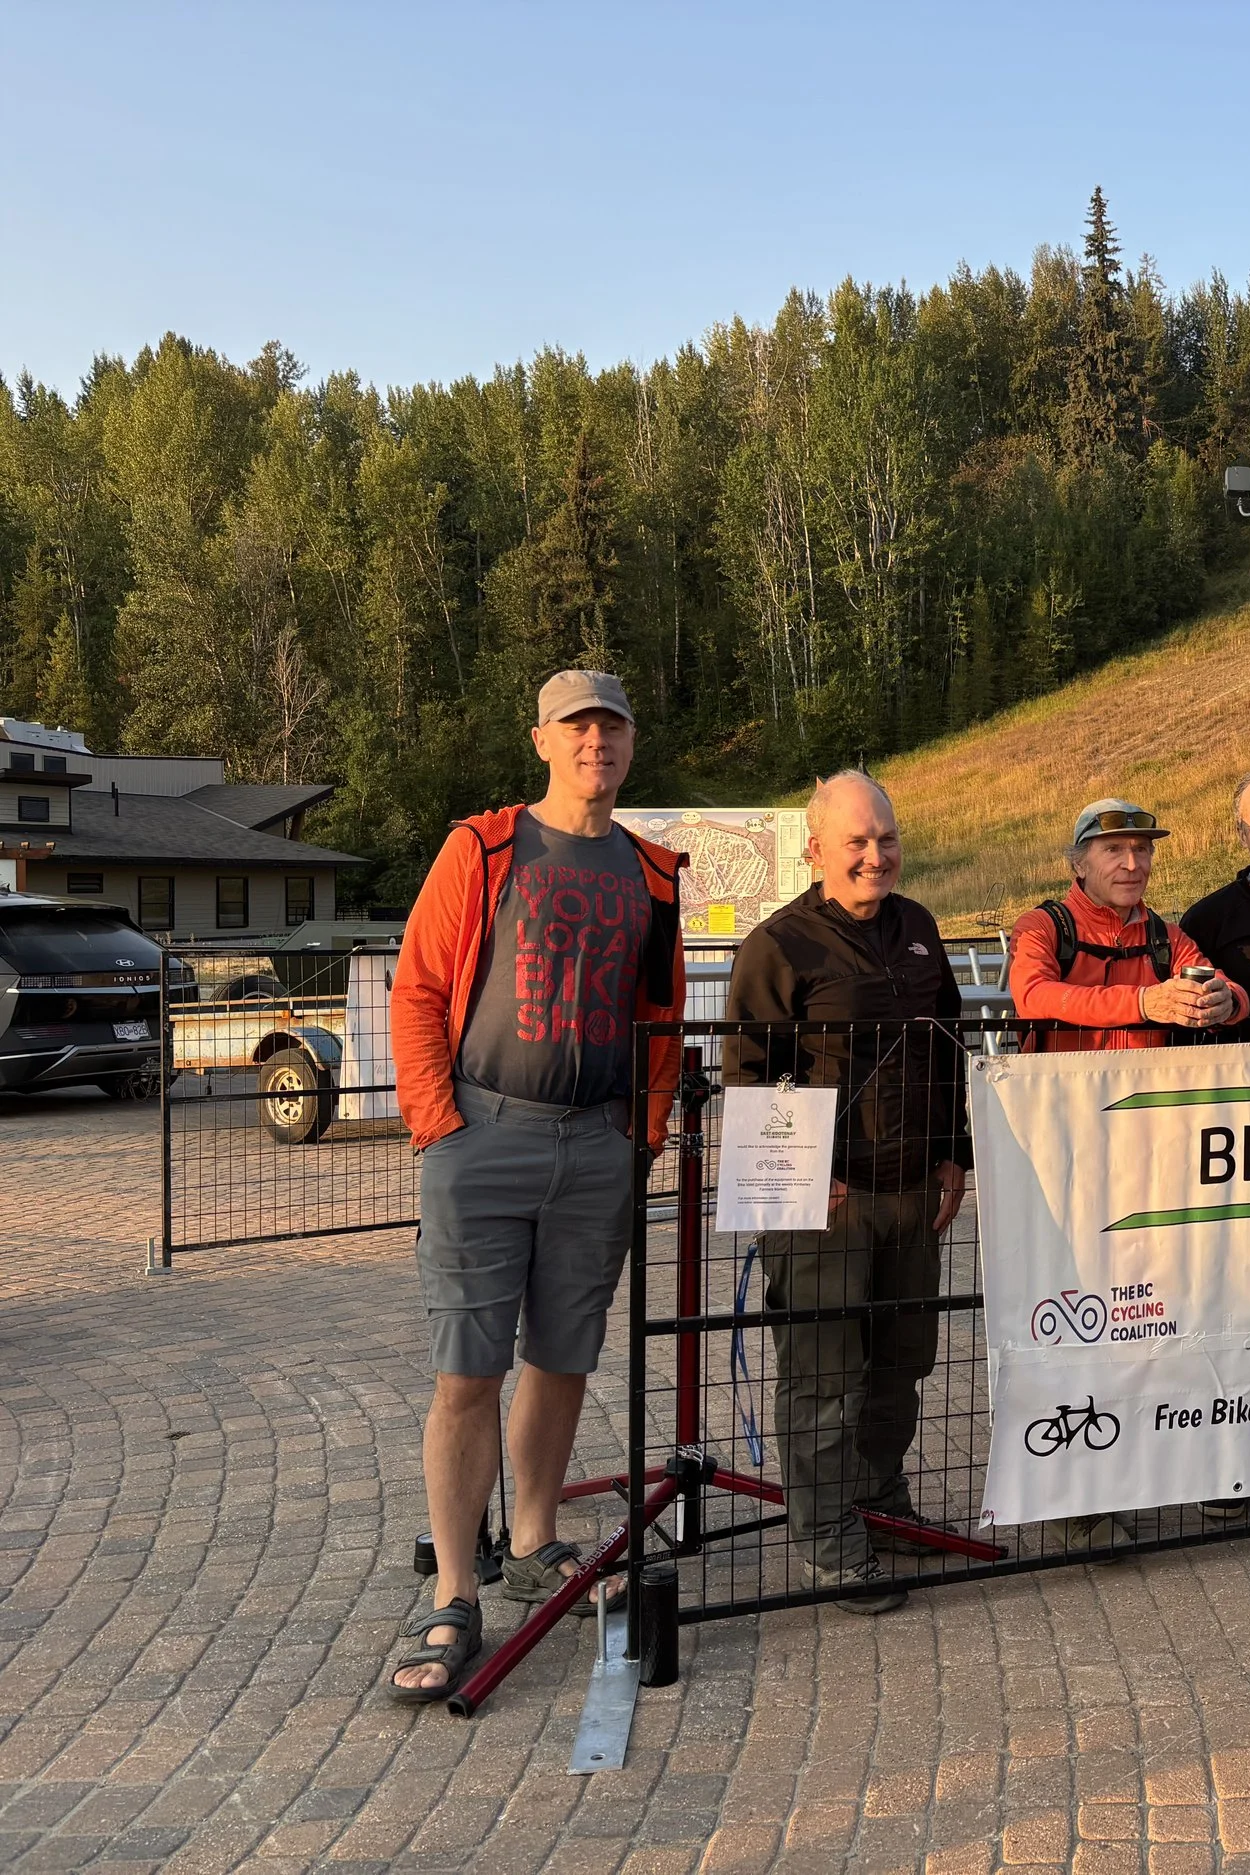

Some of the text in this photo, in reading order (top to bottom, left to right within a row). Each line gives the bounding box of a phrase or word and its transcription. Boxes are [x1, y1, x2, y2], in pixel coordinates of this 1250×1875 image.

[1110, 1282, 1153, 1302] THE BC
[1111, 1301, 1164, 1323] CYCLING
[1110, 1321, 1177, 1342] COALITION
[1154, 1403, 1202, 1431] Free
[573, 1526, 626, 1579] FEEDBACK
